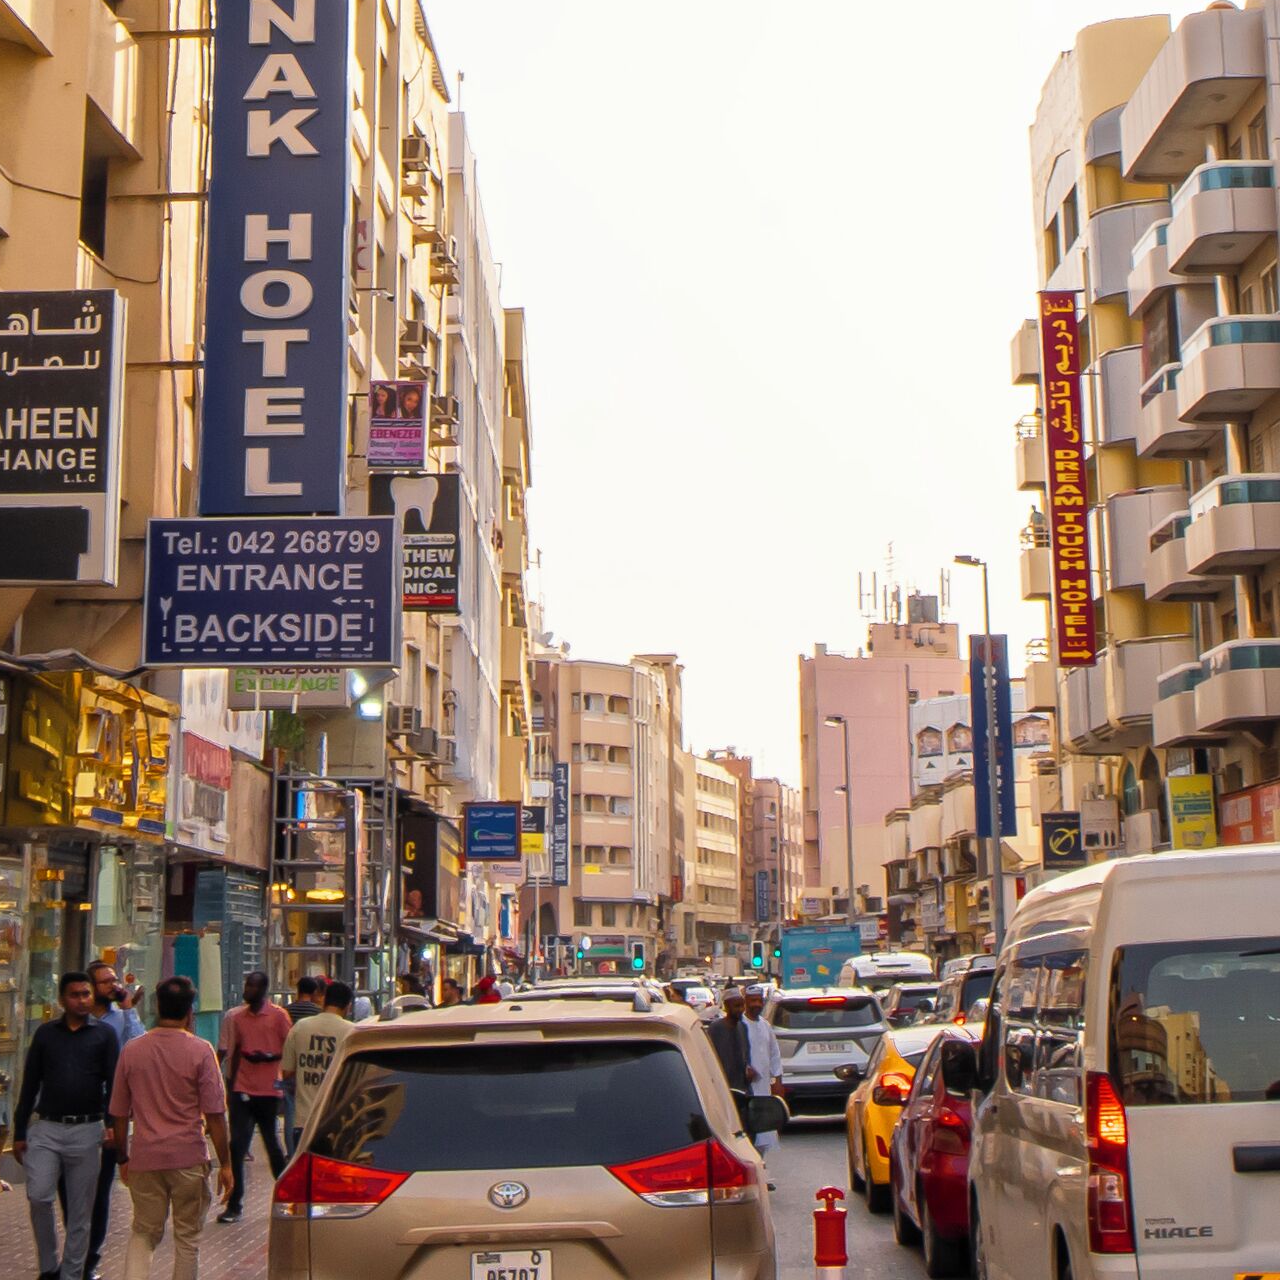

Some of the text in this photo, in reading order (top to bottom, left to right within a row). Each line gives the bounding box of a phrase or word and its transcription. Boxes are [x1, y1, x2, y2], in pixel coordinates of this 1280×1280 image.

[238, 212, 315, 497] HOTEL
[371, 429, 422, 440] EBENEZER
[1054, 449, 1083, 506] DREAM
[227, 531, 275, 554] 042
[284, 530, 380, 554] 268799
[1056, 512, 1086, 569] TOUCH
[403, 548, 455, 563] THEW
[176, 564, 363, 592] ENTRANCE
[403, 566, 456, 579] DICAL
[1061, 580, 1087, 637] HOTEL
[174, 614, 363, 643] BACKSIDE
[234, 677, 339, 692] EXCHANGE
[1144, 1226, 1214, 1240] HIACE
